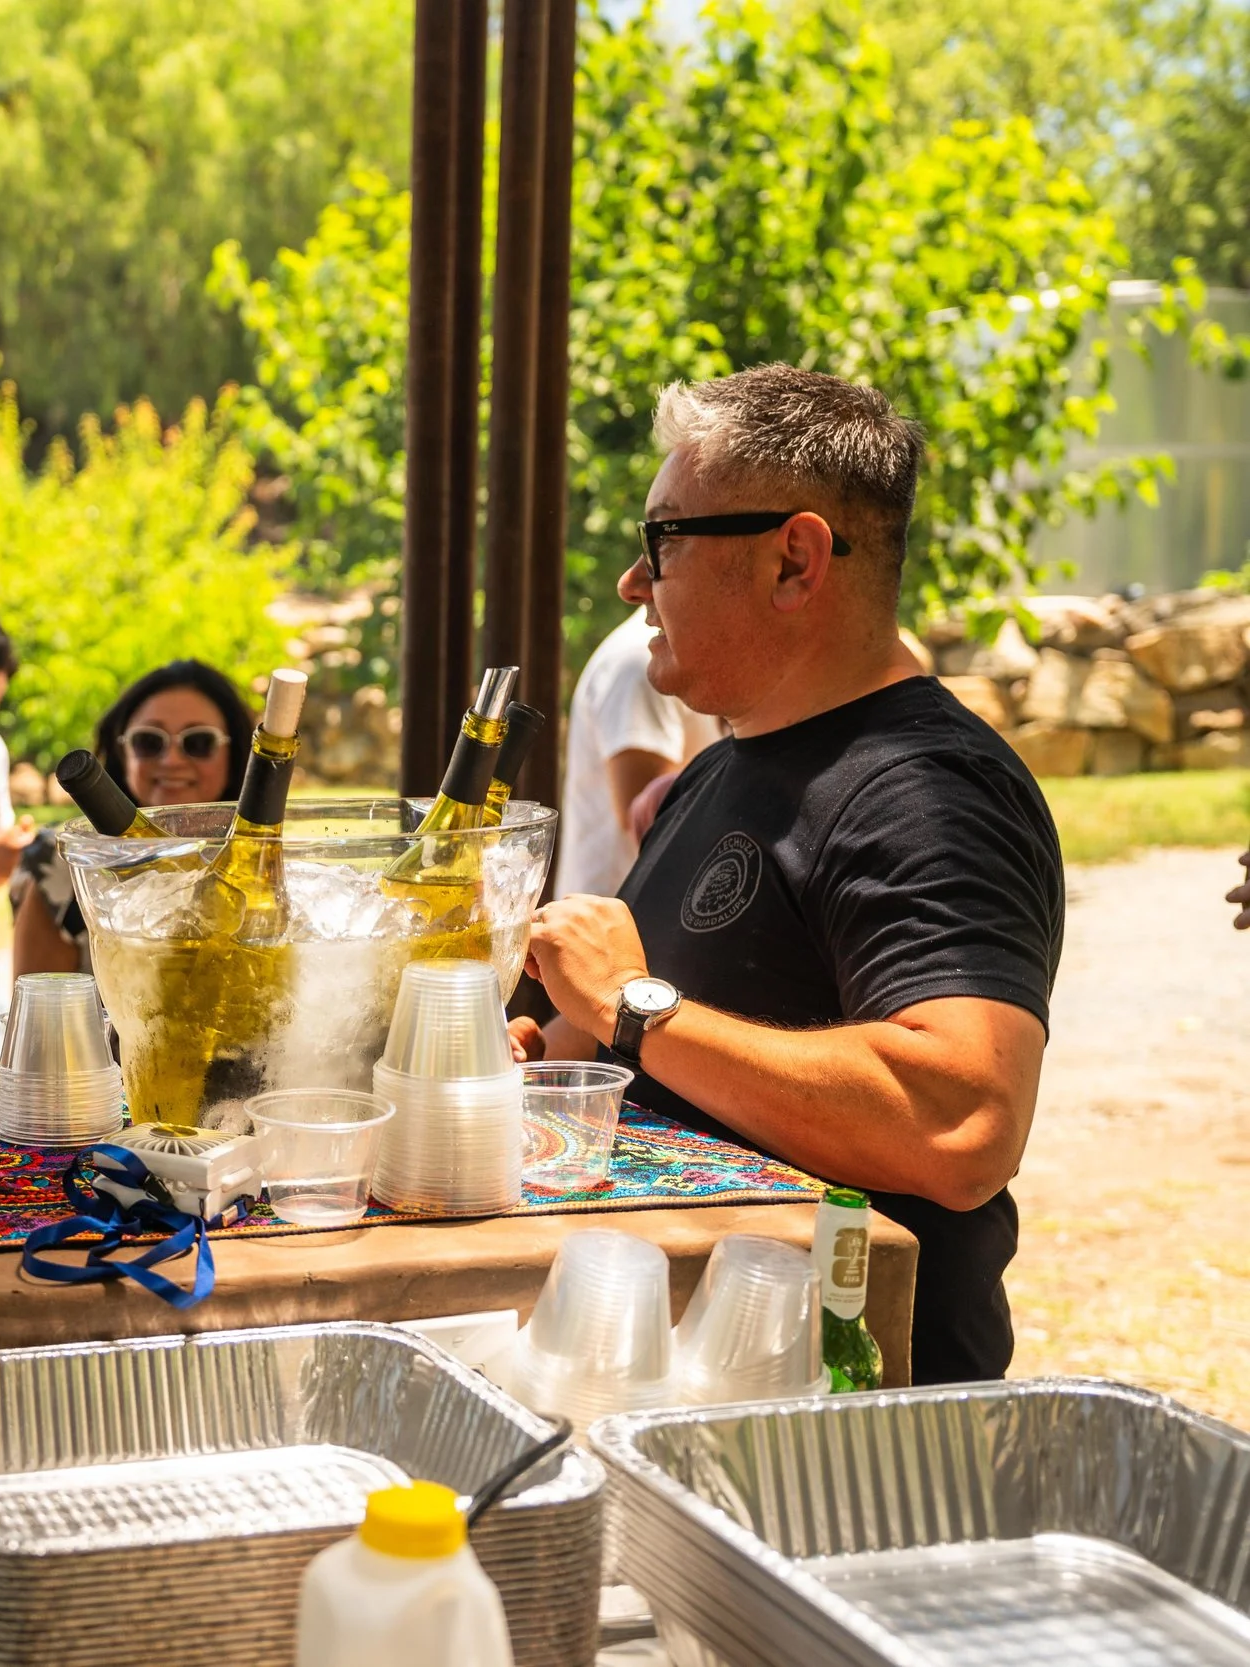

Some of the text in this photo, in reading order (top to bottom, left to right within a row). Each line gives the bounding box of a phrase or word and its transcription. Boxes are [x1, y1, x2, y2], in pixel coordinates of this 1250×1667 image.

[718, 838, 756, 858] LECHUZA
[694, 896, 748, 928] GUADALUPE
[843, 1275, 860, 1284] FIFA
